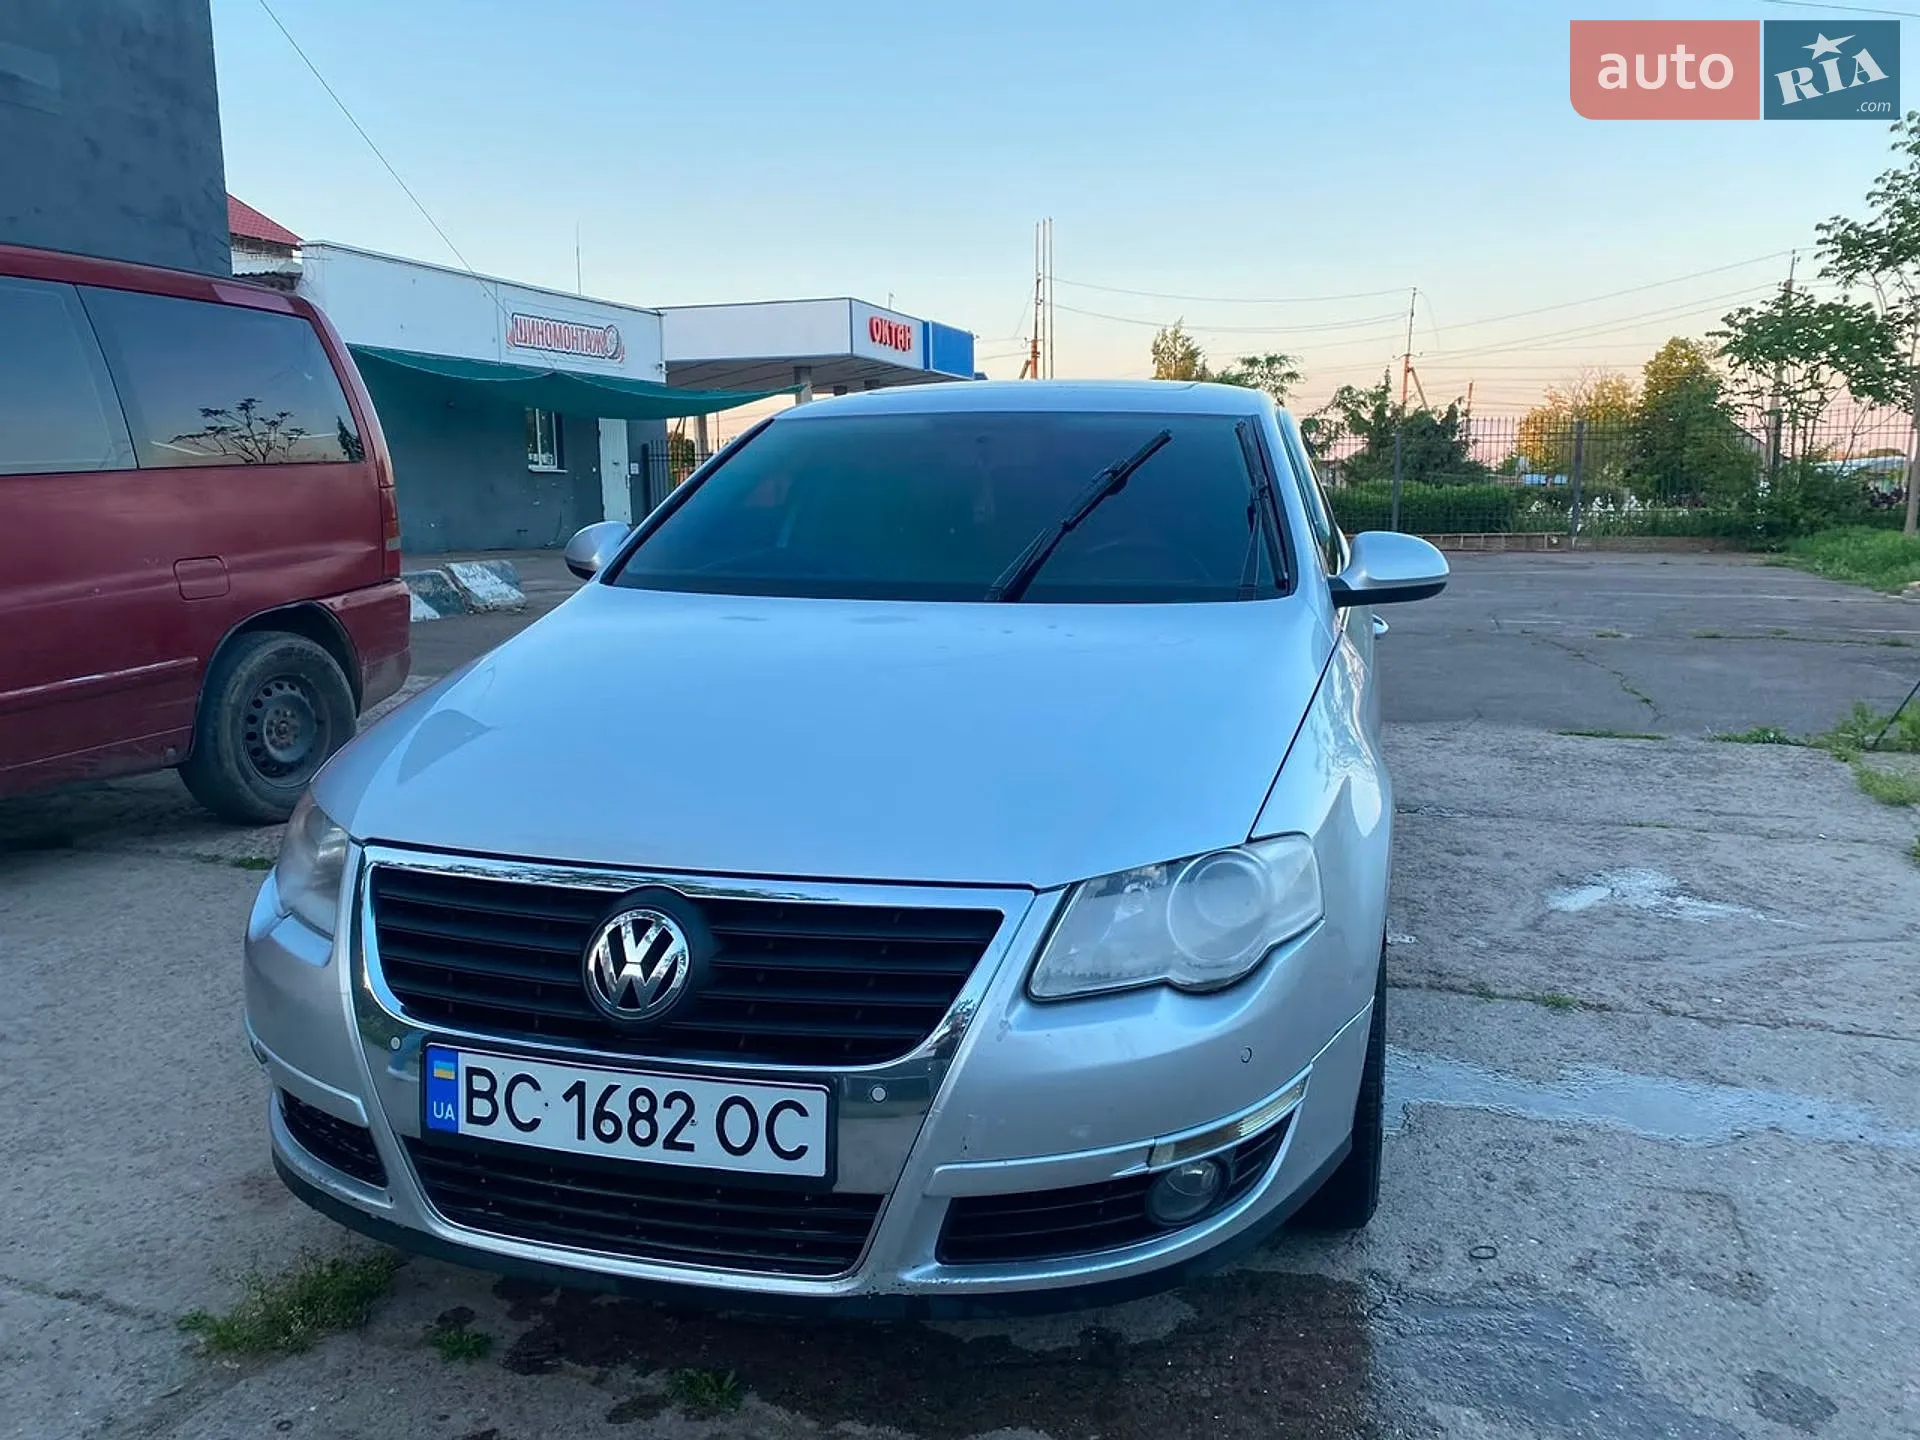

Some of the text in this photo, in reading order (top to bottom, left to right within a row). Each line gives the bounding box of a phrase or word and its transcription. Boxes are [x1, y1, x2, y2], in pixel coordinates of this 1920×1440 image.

[514, 317, 606, 355] ШИНОМОНТАЖ
[432, 1100, 456, 1122] UA
[464, 1066, 810, 1161] BC 1682 OC
